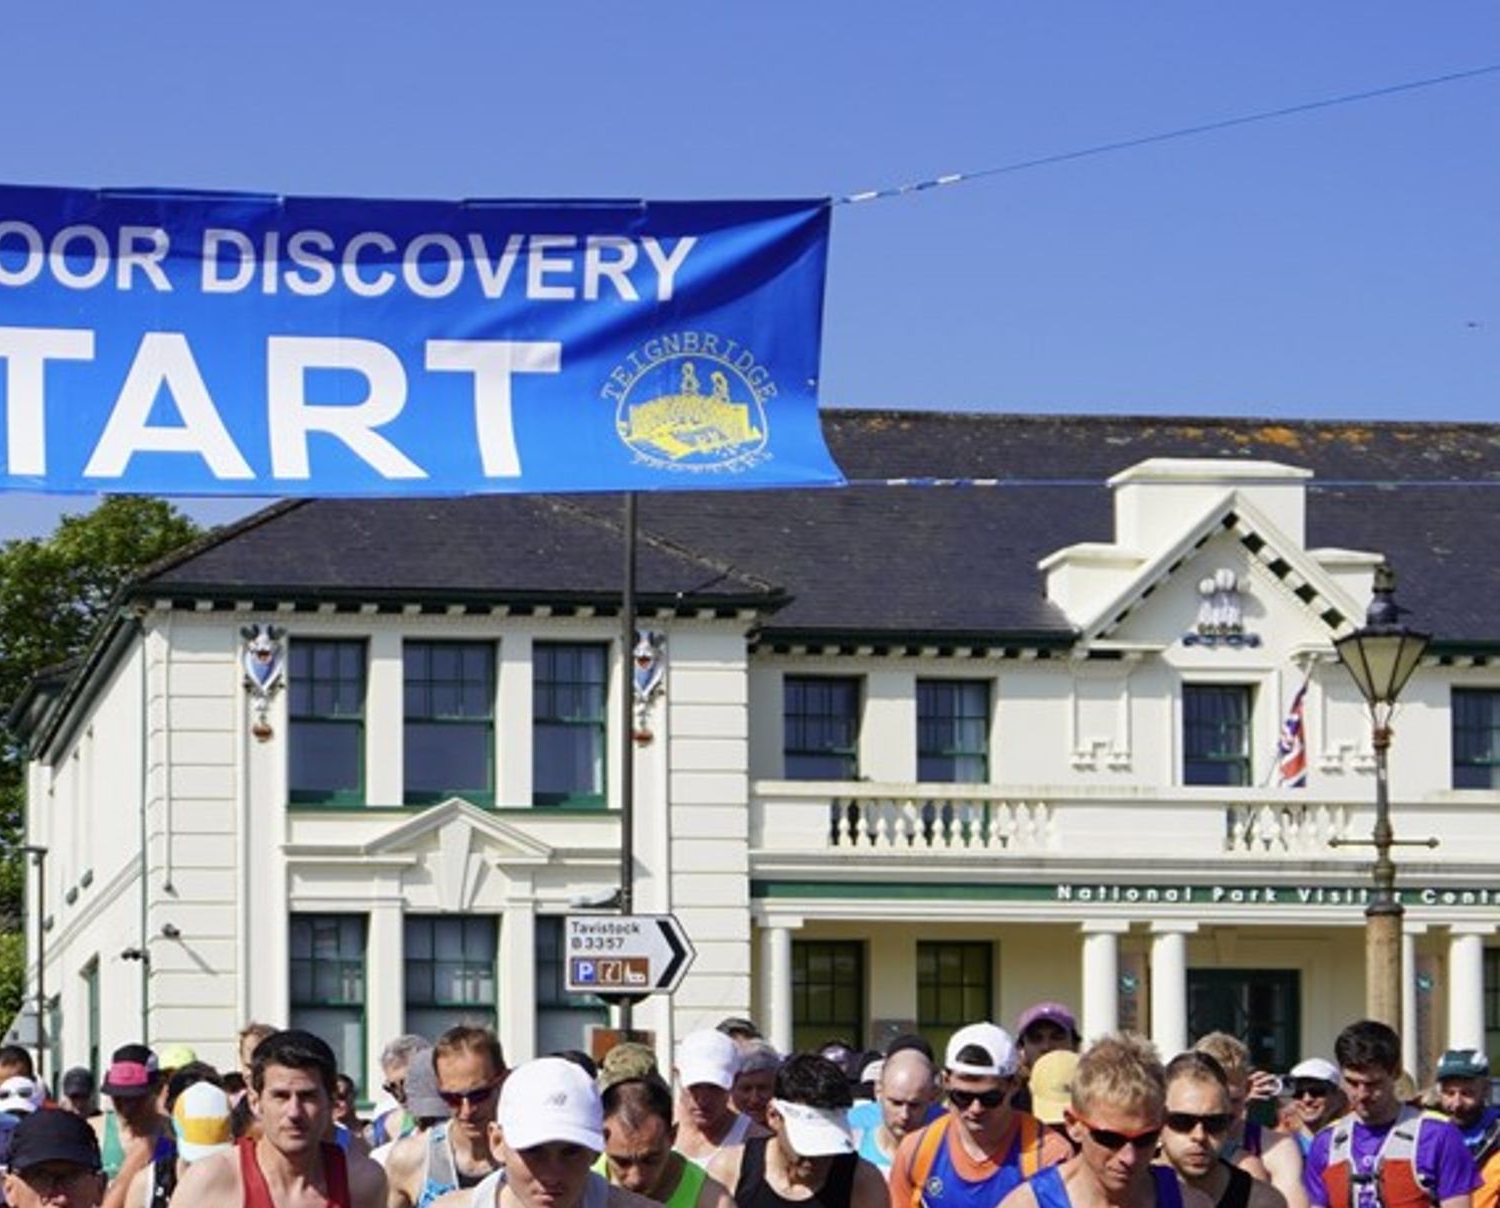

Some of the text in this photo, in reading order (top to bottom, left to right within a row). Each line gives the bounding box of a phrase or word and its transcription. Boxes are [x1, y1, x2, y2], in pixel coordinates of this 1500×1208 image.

[201, 227, 699, 302] DISCOVERY
[601, 330, 779, 401] TEIGNBRIDGE
[1057, 884, 1192, 901] National
[1212, 885, 1278, 902] Park
[1297, 887, 1402, 904] Visitr
[571, 921, 641, 934] Tavistock
[578, 962, 594, 982] P
